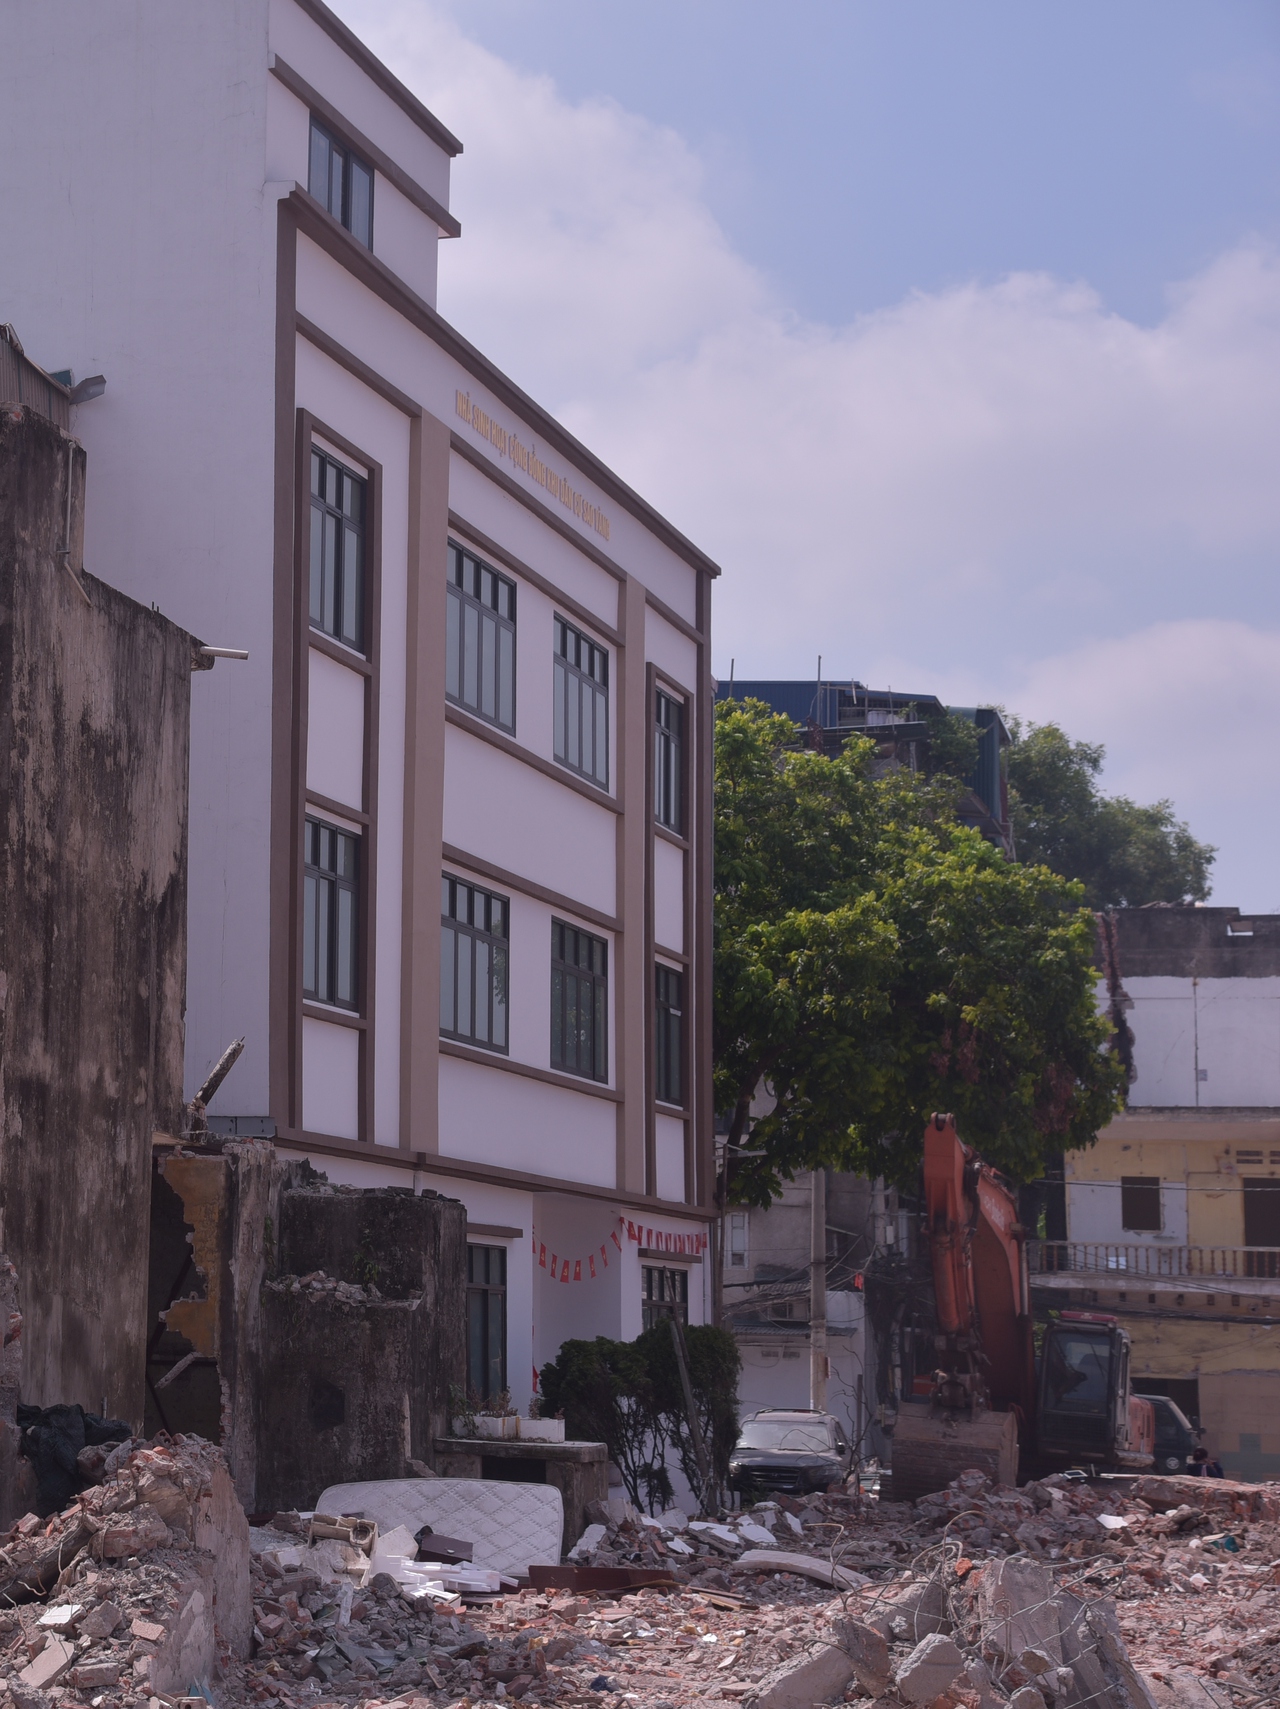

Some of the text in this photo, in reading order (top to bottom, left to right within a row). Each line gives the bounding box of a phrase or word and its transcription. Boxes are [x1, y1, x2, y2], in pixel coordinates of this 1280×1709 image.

[456, 389, 472, 424] NHÀ
[472, 405, 490, 440] SINH
[490, 420, 508, 457] HOẠT
[509, 434, 527, 471] CỘNG
[546, 467, 559, 499] KHU
[559, 478, 572, 511] DÂN
[582, 500, 594, 528] SAO
[594, 507, 610, 542] VÀNG
